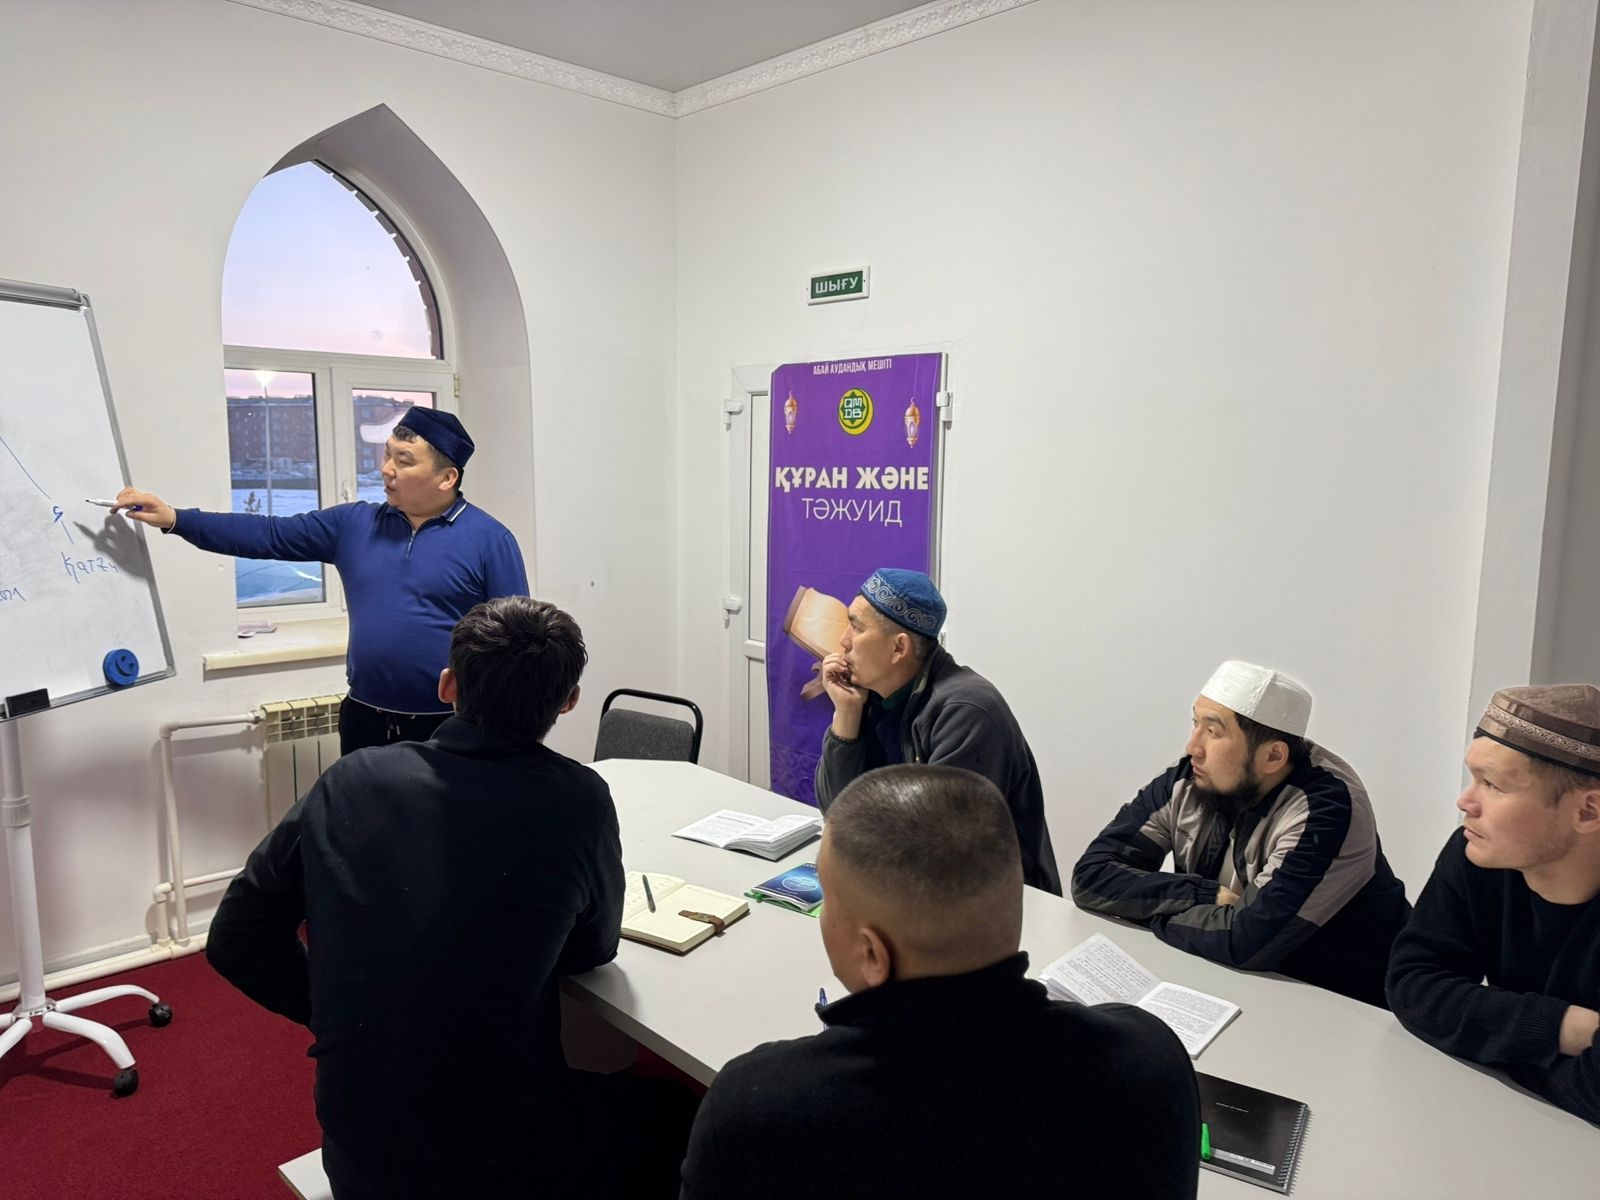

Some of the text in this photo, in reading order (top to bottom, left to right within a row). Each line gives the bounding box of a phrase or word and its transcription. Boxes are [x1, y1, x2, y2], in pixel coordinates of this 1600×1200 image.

[815, 276, 859, 294] ШЫҒУ
[813, 358, 892, 375] АБАЙ АУДАНДЫҚ МЕШІТІ
[775, 466, 929, 493] ҚҰРАН ЖӘНЕ
[801, 497, 903, 528] ТӘЖУИД
